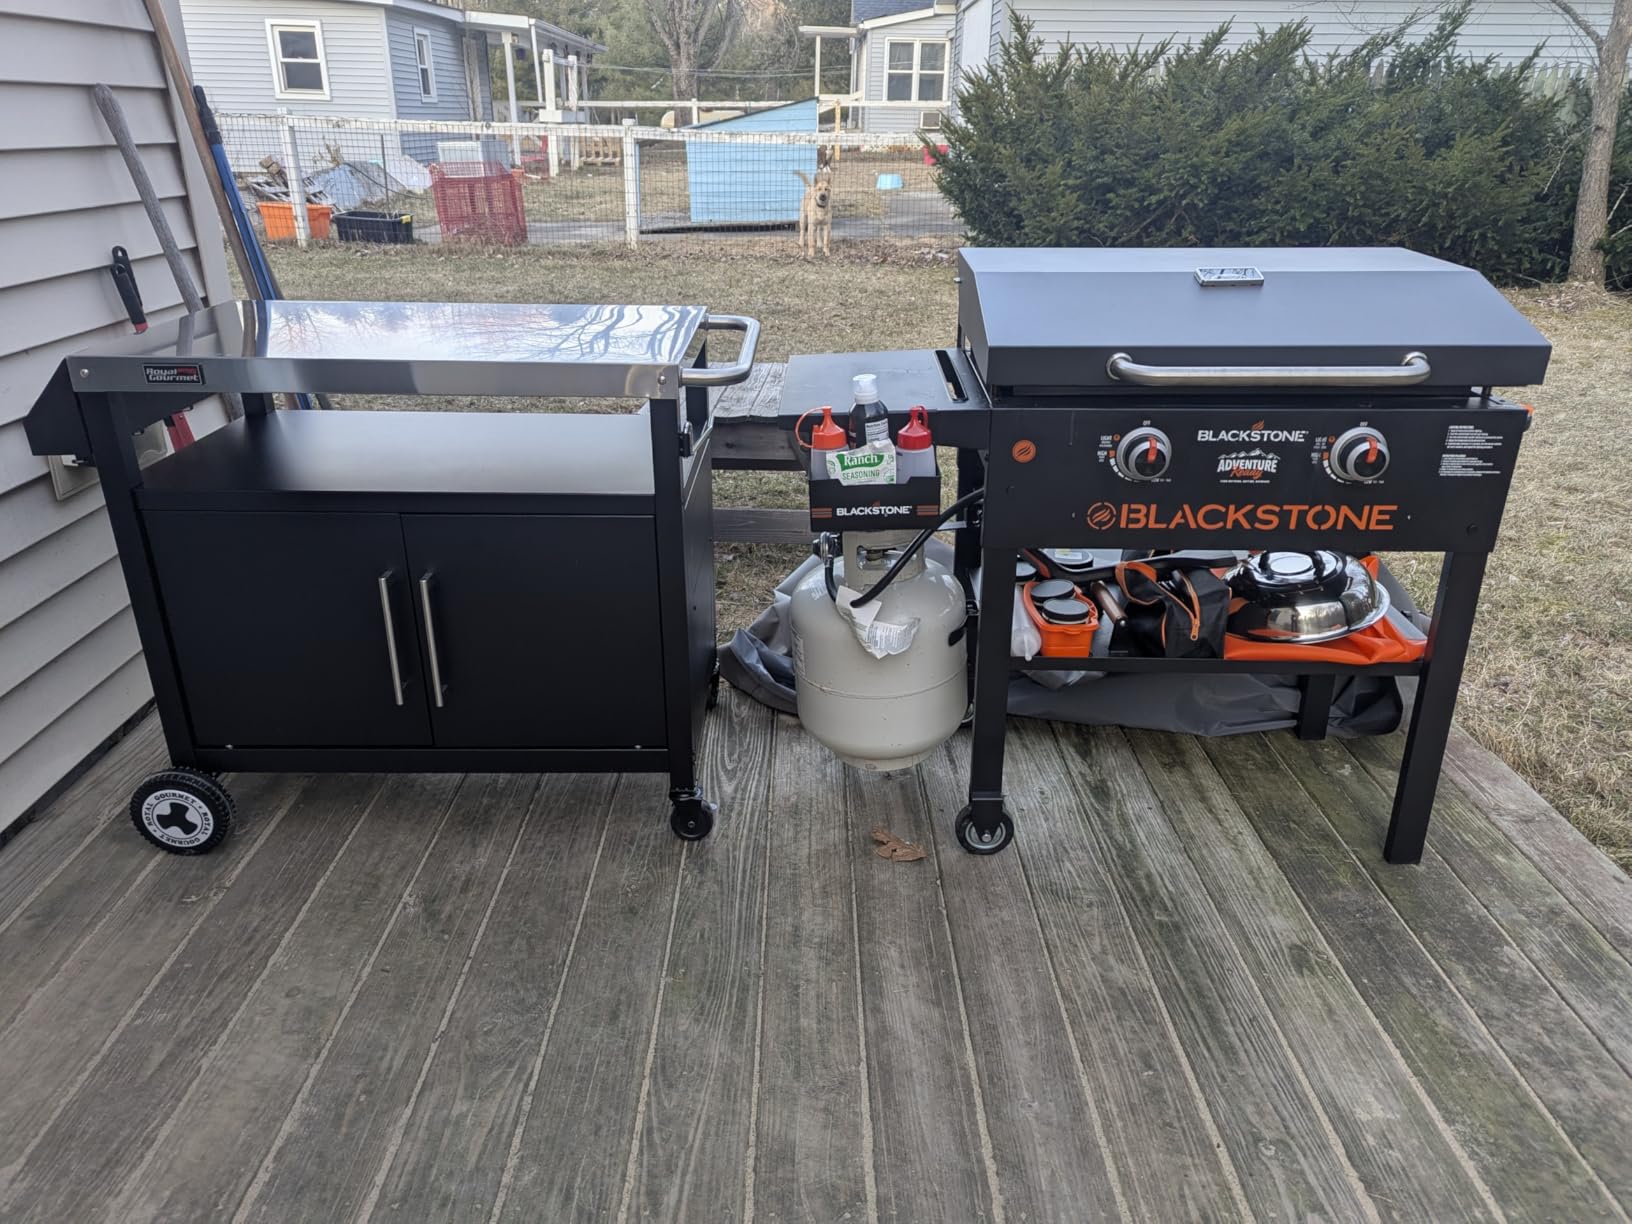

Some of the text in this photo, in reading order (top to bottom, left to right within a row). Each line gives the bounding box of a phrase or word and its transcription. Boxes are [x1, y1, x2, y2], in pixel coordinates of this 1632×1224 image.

[1197, 430, 1305, 442] BLACKSTONE
[843, 453, 879, 467] Ranch
[1217, 459, 1278, 473] ADVENTURE
[842, 469, 880, 480] SEASONING
[1229, 468, 1264, 480] Ready
[836, 505, 911, 516] BLACKSTONE
[1119, 503, 1399, 531] BLACKSTONE
[154, 792, 198, 804] GOURMET
